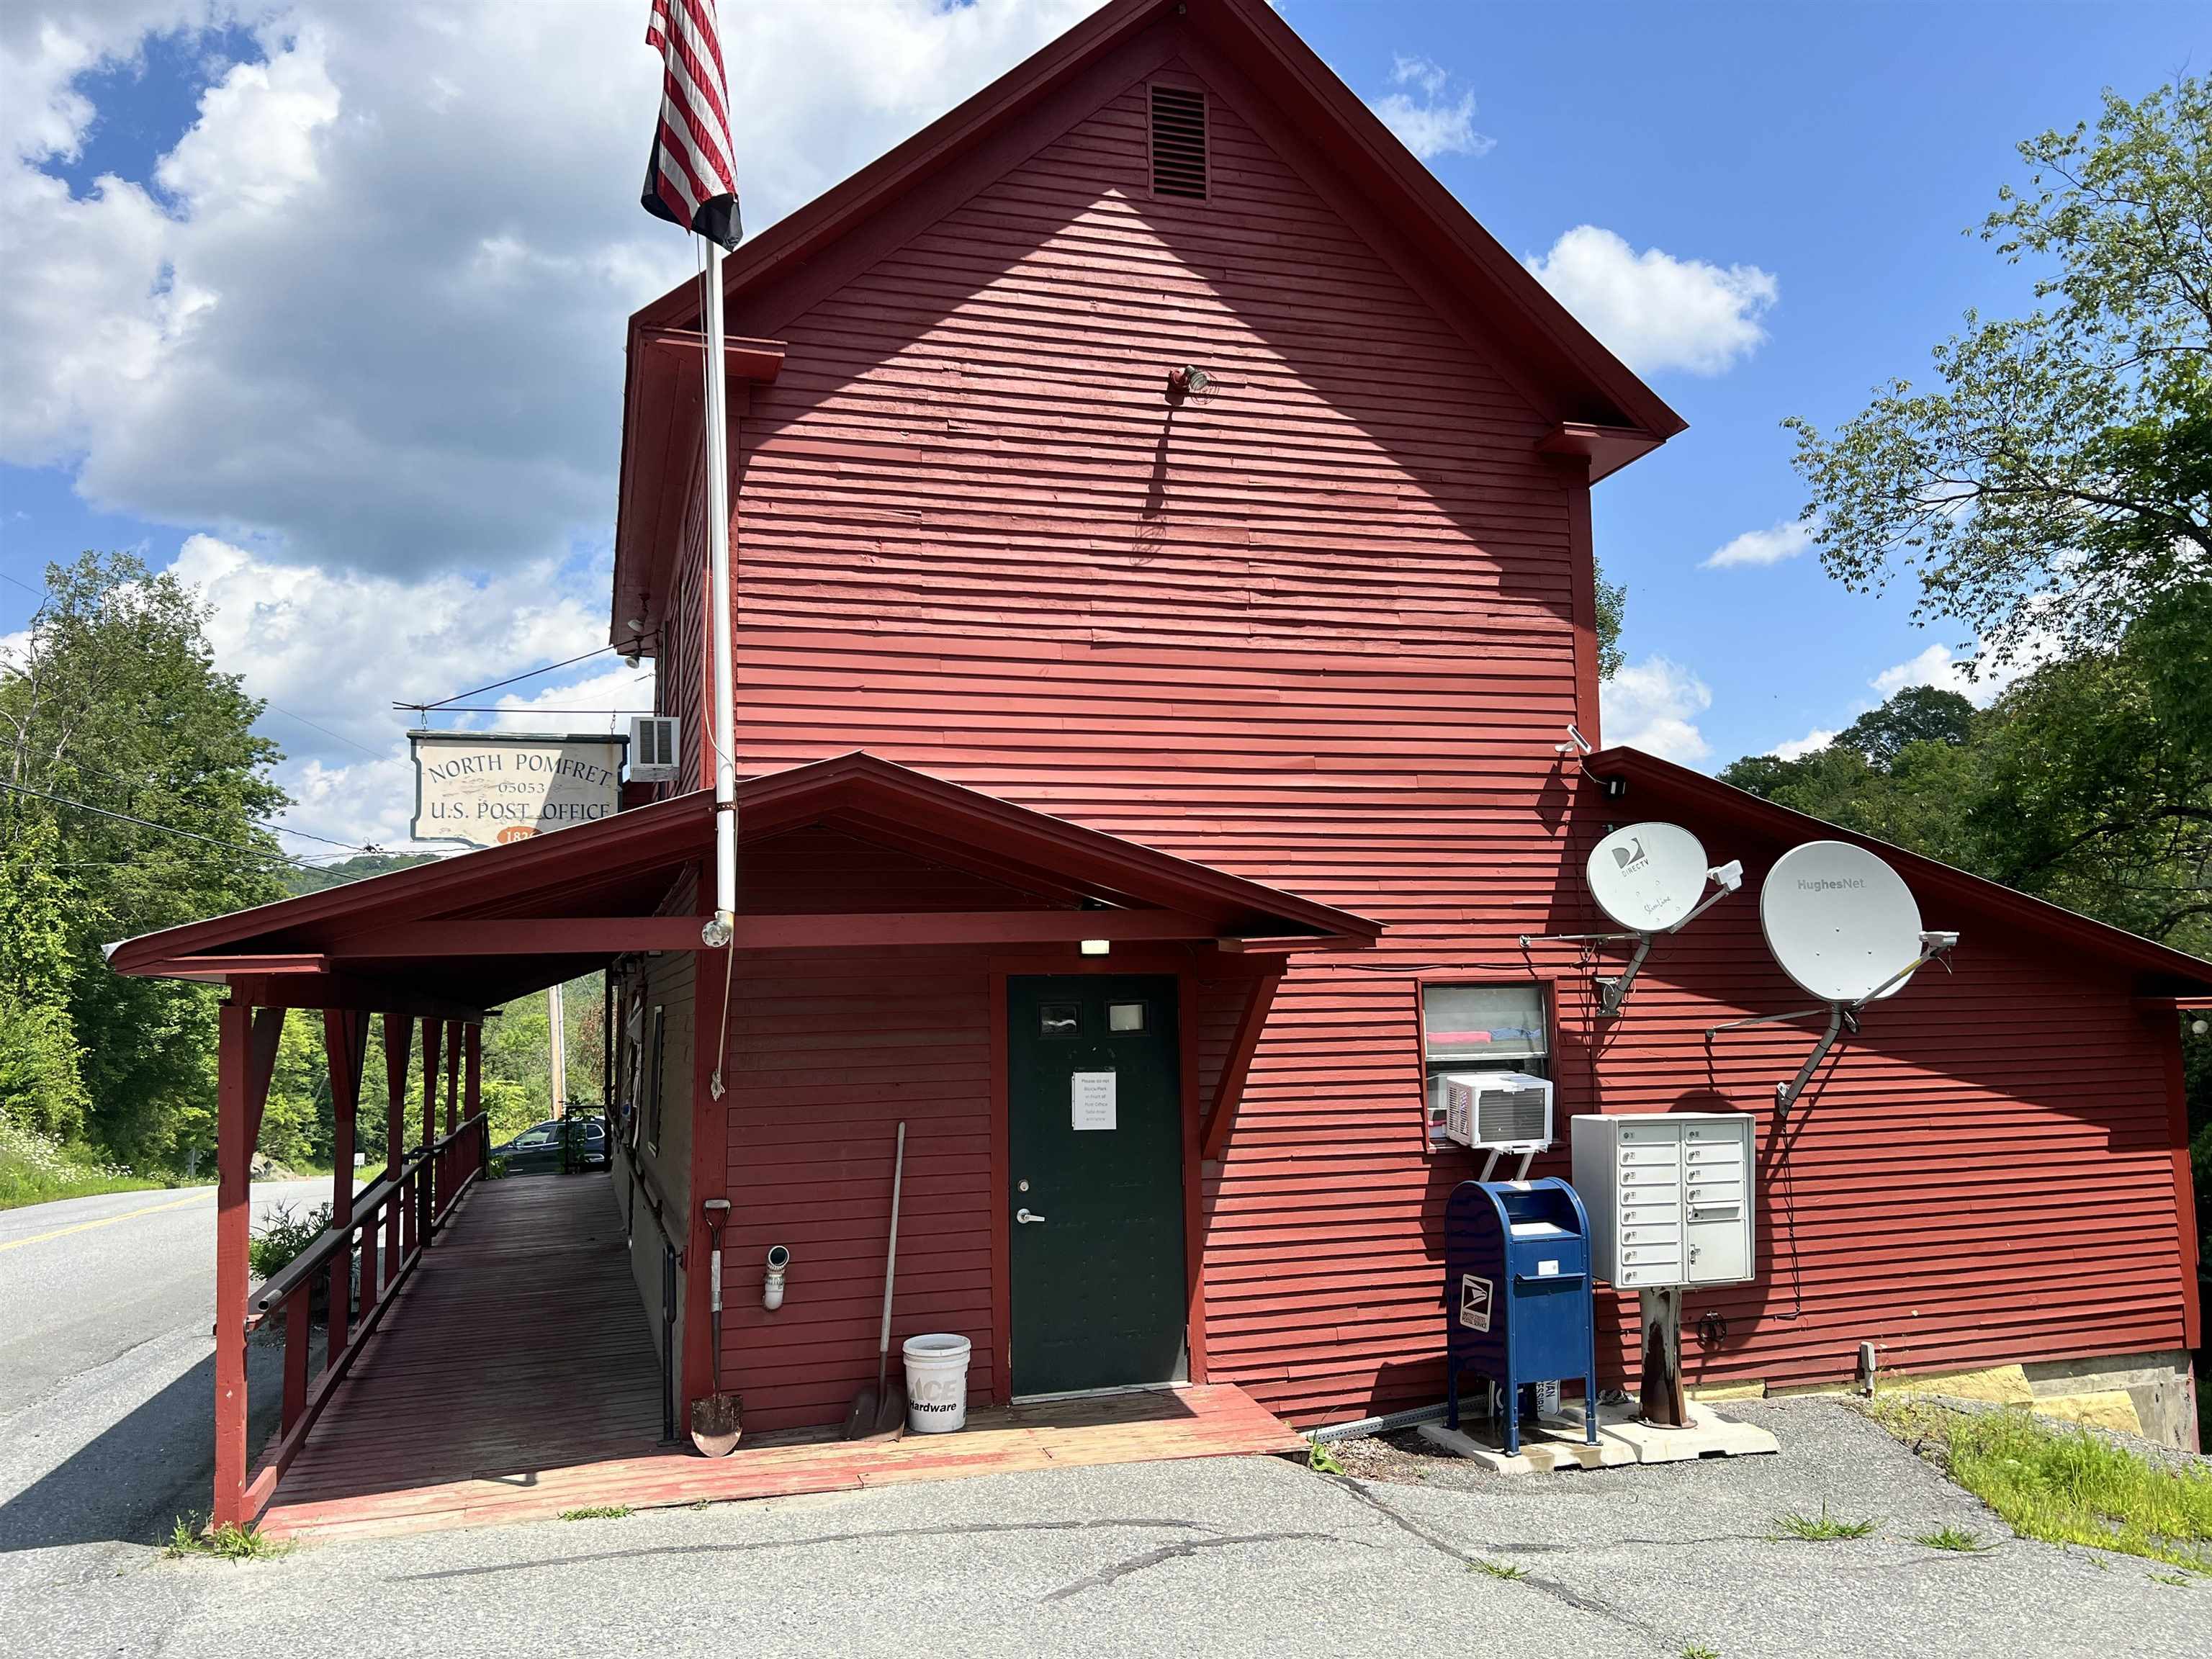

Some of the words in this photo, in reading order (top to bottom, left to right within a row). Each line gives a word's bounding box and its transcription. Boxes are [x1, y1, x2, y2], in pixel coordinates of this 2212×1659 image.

[428, 754, 502, 783] NORTH
[516, 753, 613, 786] POMFRET
[498, 782, 545, 793] 05053
[431, 801, 469, 819] U.S.
[477, 801, 529, 819] POST
[543, 802, 611, 820] OFFICE
[1622, 858, 1649, 877] DIRECTV
[1797, 878, 1866, 892] HughesNet
[1546, 1379, 1556, 1398] VAN
[909, 1399, 957, 1413] Hardware
